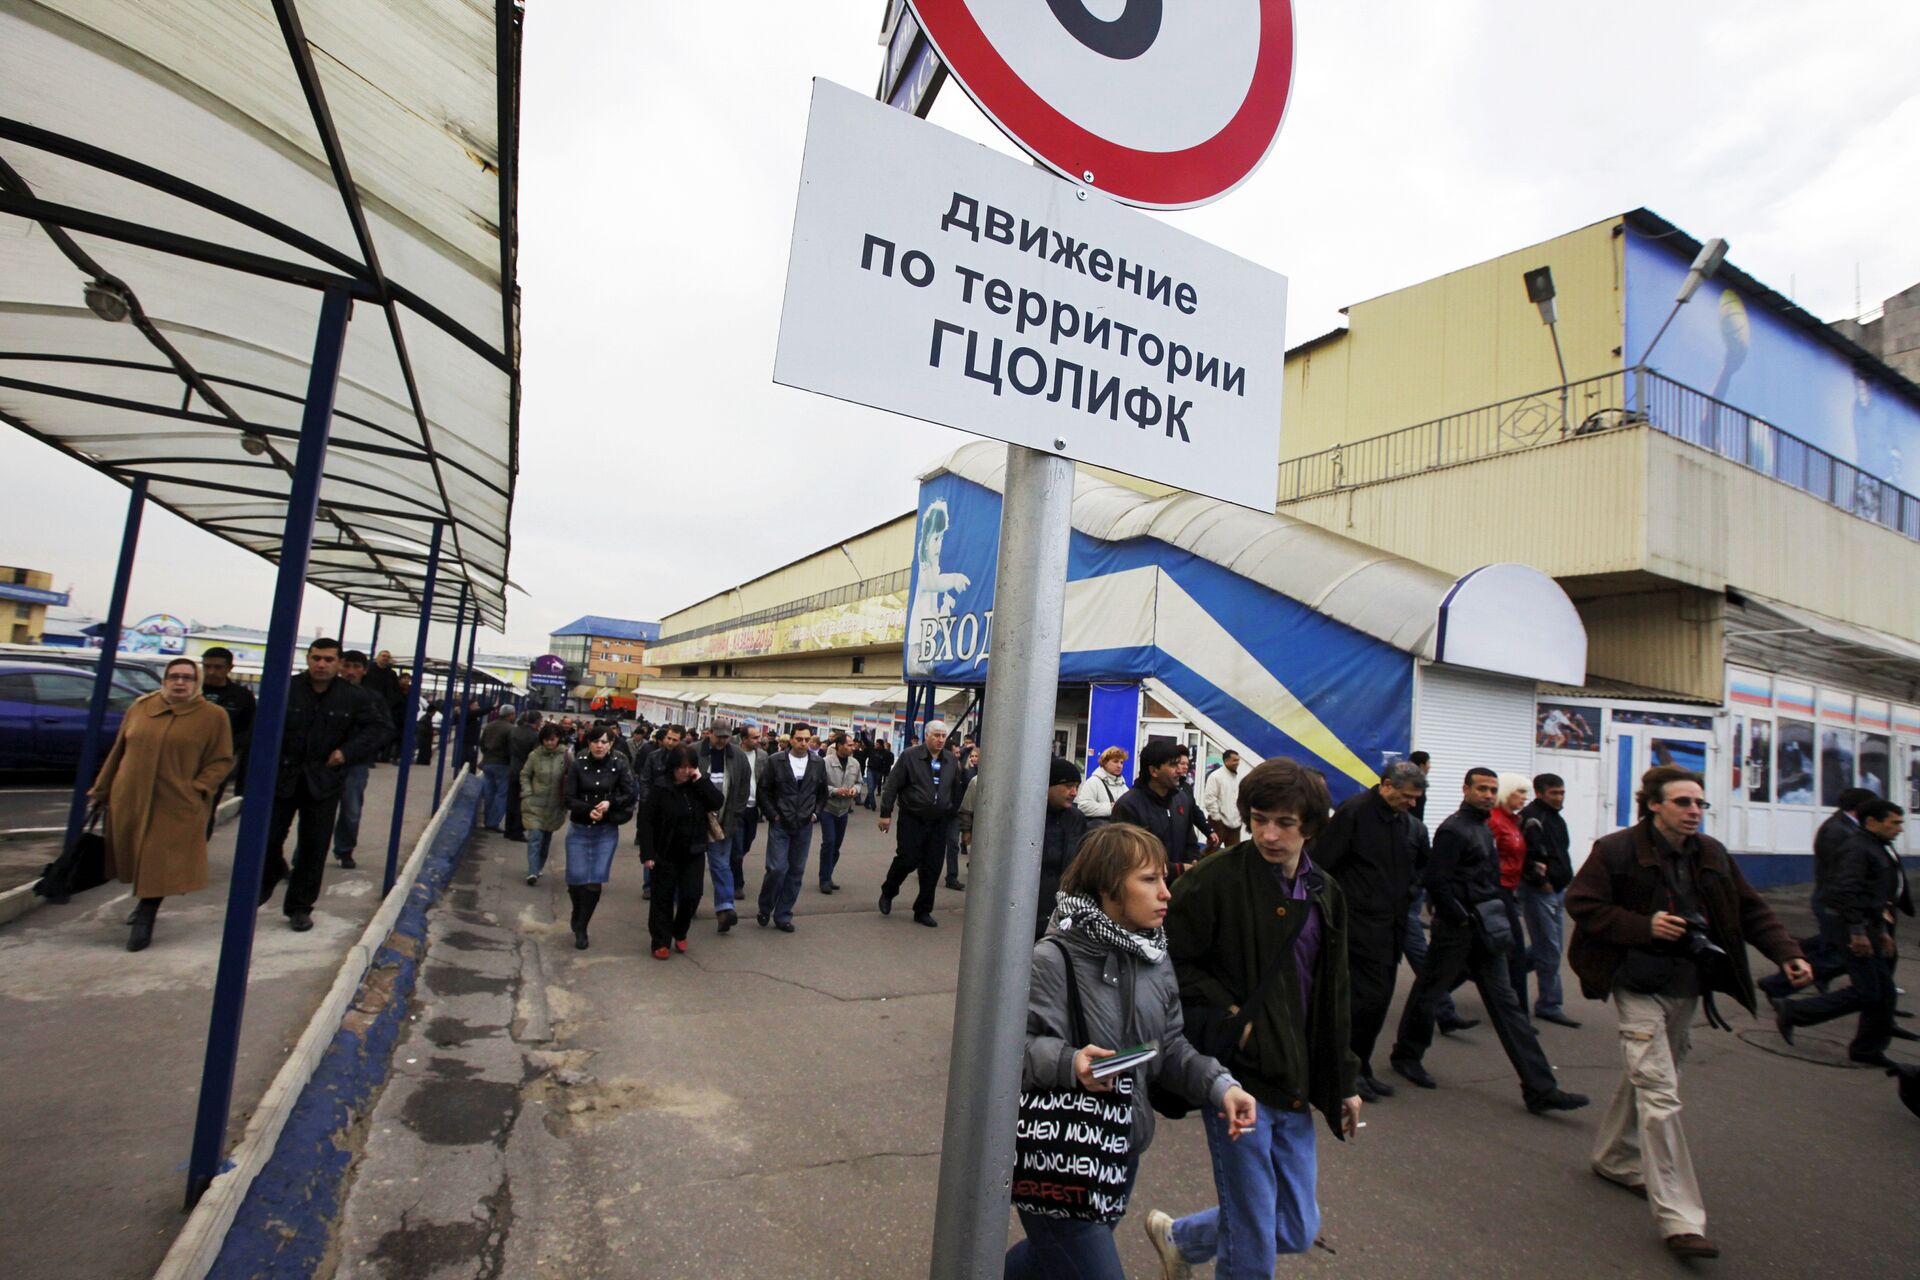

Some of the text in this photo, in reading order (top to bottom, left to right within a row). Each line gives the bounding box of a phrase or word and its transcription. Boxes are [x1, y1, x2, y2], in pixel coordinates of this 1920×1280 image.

[860, 232, 1246, 397] по территории
[940, 191, 1198, 315] движение
[929, 318, 1194, 443] ГЦОЛИФК
[1023, 1149, 1100, 1178] MÜNCHEN
